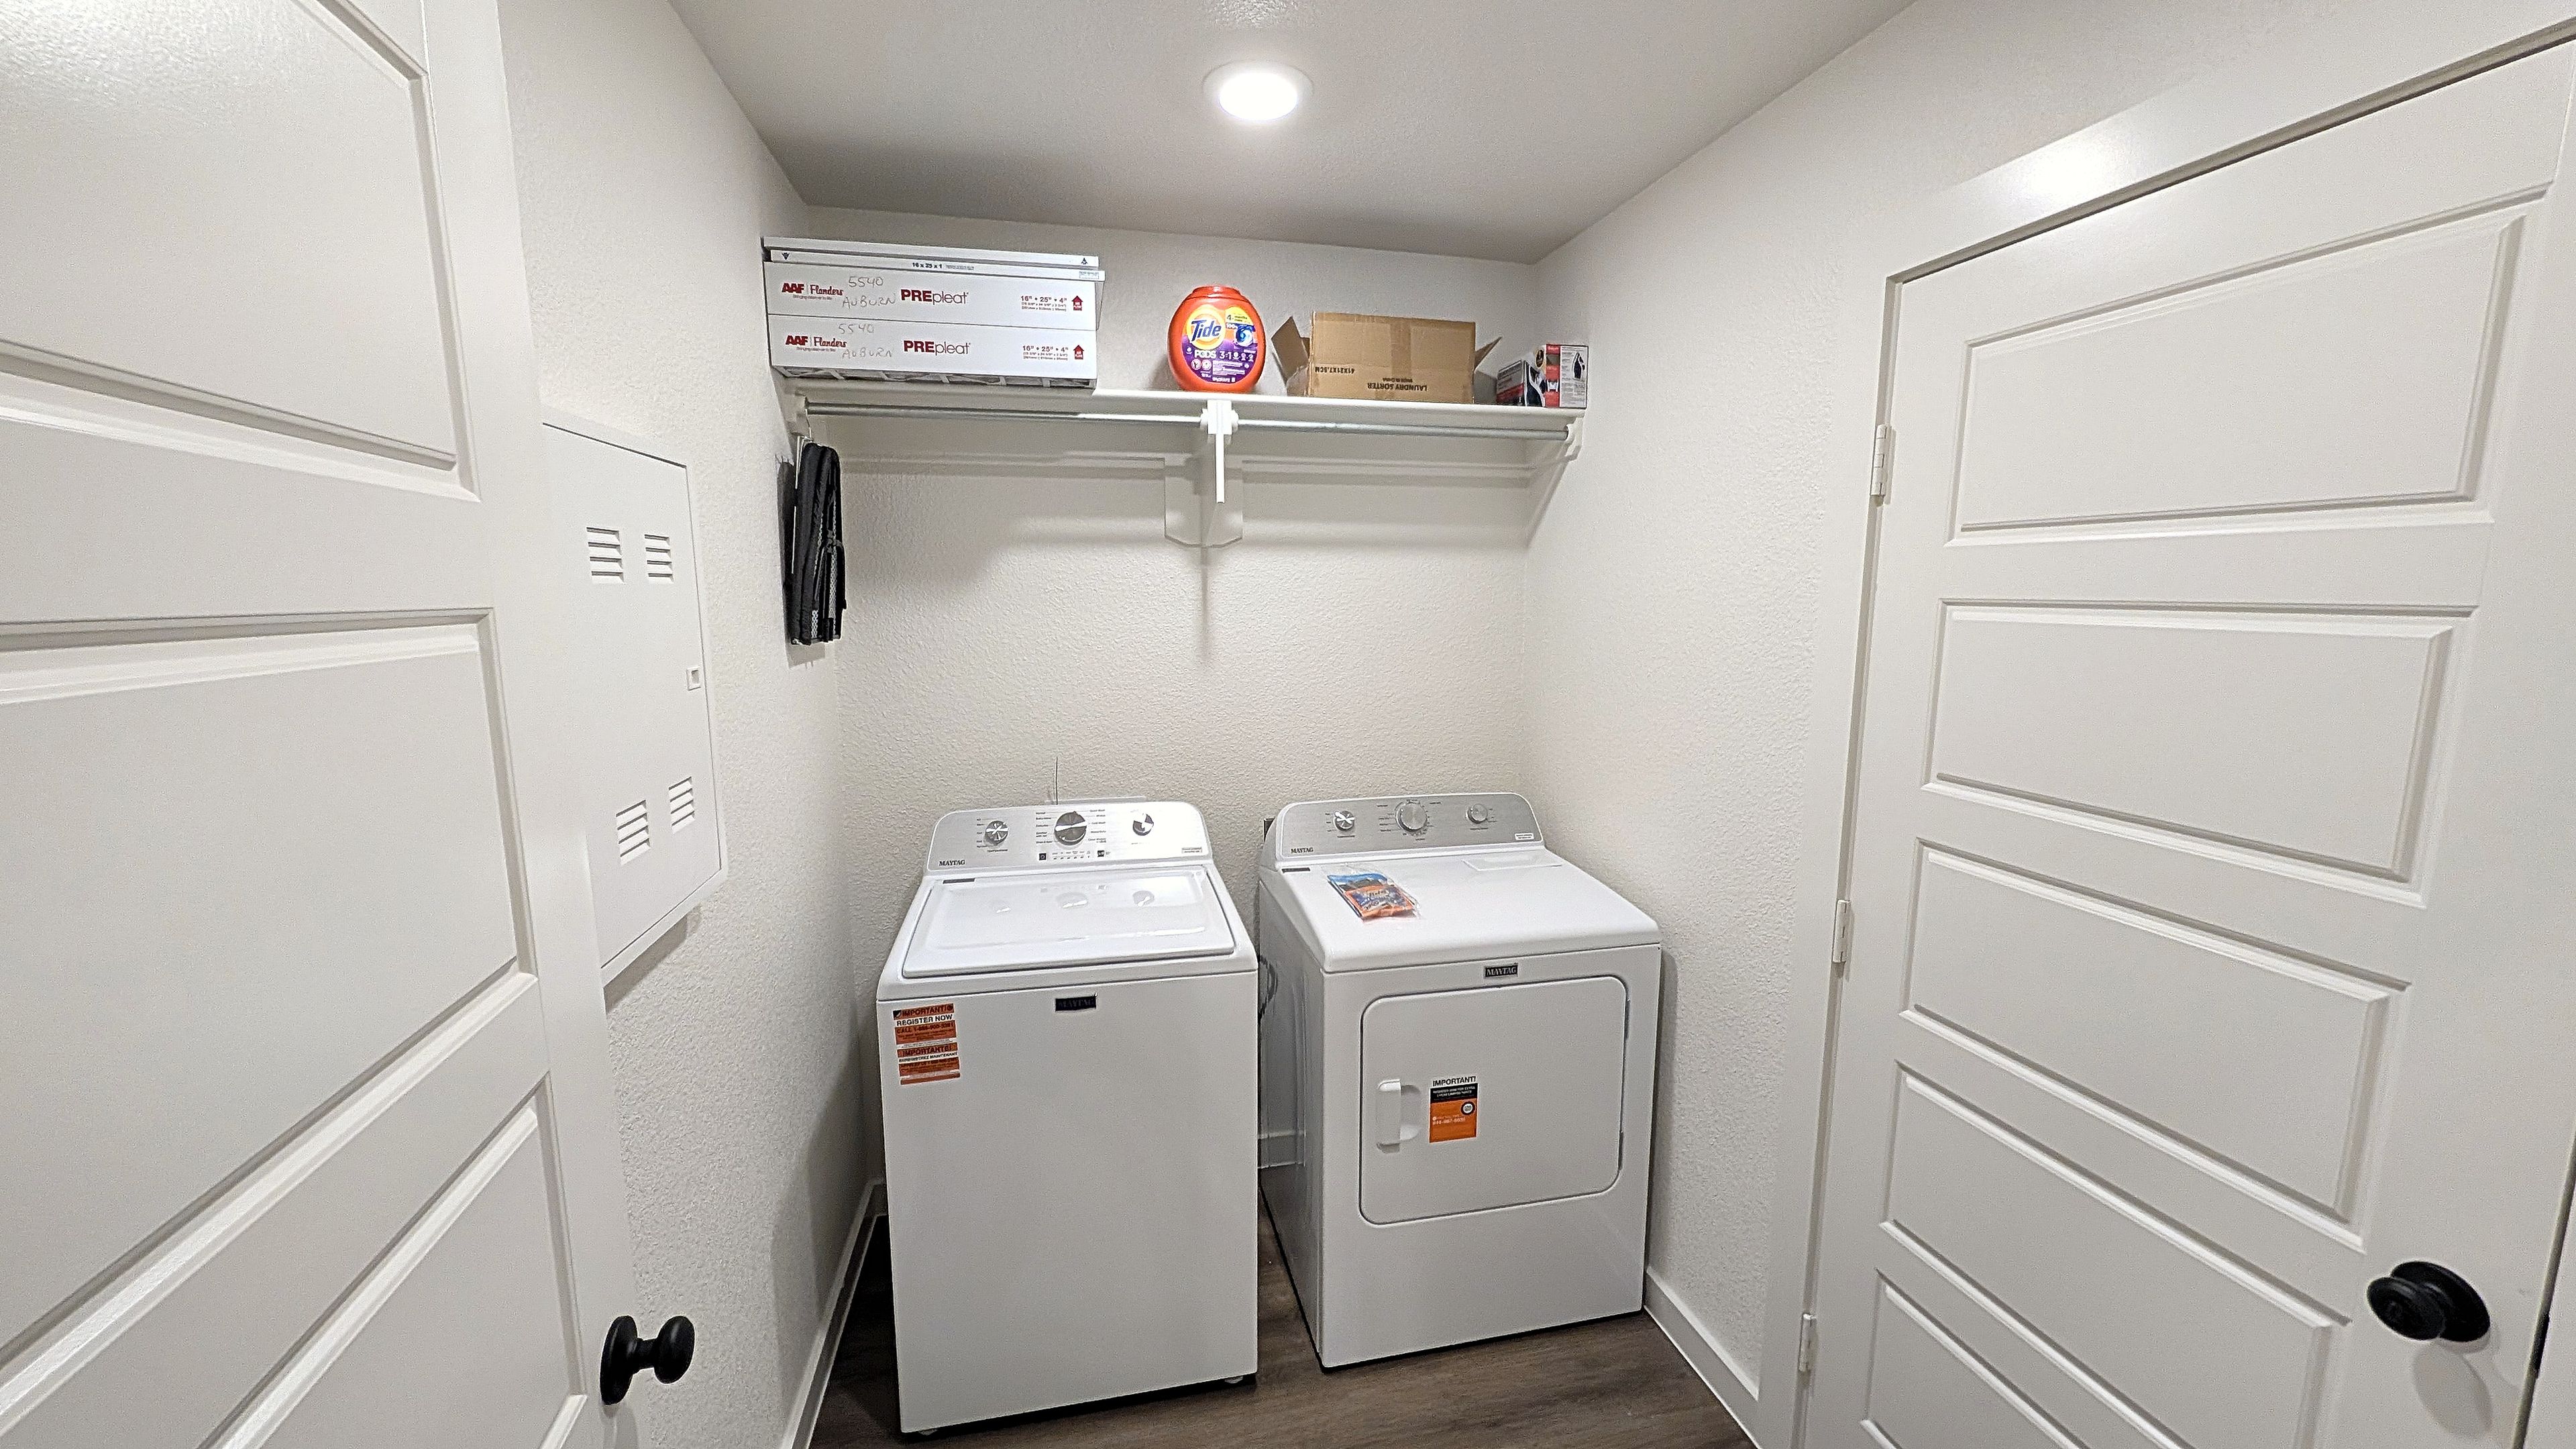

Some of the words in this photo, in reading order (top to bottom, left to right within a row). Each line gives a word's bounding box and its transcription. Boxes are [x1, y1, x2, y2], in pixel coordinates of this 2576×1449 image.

[848, 276, 884, 288] 5540
[782, 283, 805, 294] AAF
[810, 284, 844, 296] Flanders
[843, 293, 896, 309] AUBURN
[839, 323, 874, 334] 5540
[1191, 320, 1222, 342] Tide
[785, 335, 808, 345] AAF
[813, 336, 847, 347] Flanders
[843, 347, 893, 359] AUBURN
[1194, 350, 1217, 359] PODS
[1367, 382, 1393, 390] SORTER
[1395, 383, 1428, 391] LAUNDRY
[1487, 966, 1516, 976] MAYTAG
[897, 1016, 933, 1026] REGISTER
[935, 1014, 953, 1022] NOW
[1432, 1076, 1477, 1087] IMPORTANT!
